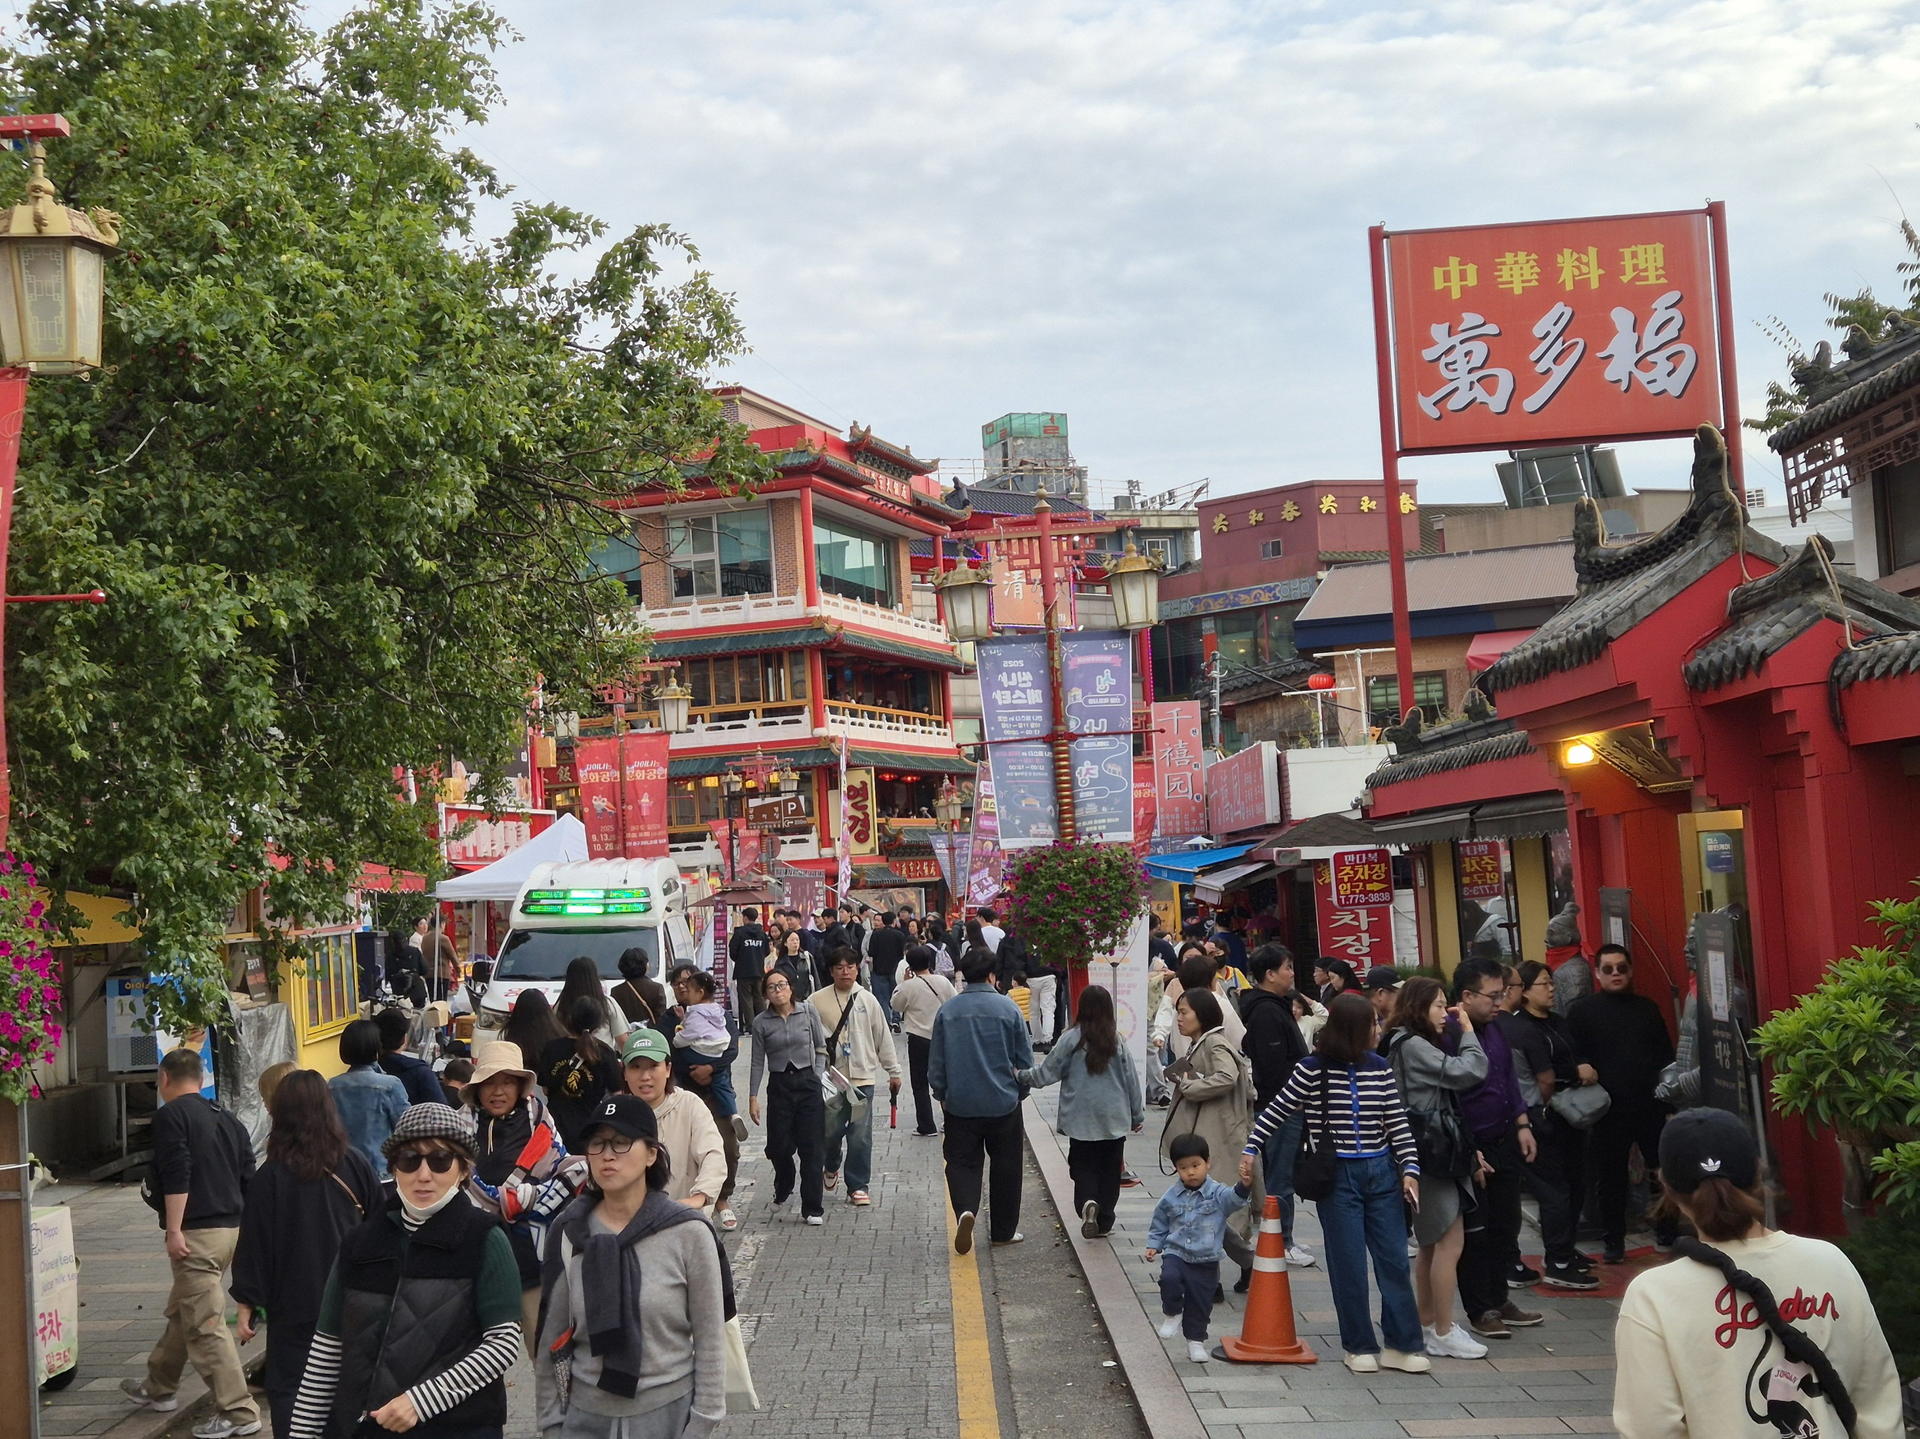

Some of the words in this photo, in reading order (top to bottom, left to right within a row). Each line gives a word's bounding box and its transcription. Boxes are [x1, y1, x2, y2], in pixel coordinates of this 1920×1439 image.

[1433, 243, 1668, 299] 中華料理
[1417, 290, 1697, 420] 萬多福
[1319, 491, 1417, 515] 共和春
[1212, 499, 1301, 534] 共和春
[1160, 708, 1195, 800] 千禧园
[788, 802, 796, 814] P
[846, 781, 871, 844] 연경
[1344, 852, 1378, 865] 만다복
[1338, 863, 1388, 882] 주차장
[1338, 882, 1365, 895] 입구
[1340, 892, 1391, 905] T.773-3838
[744, 939, 763, 947] STAFF
[605, 1103, 616, 1115] B
[1715, 1283, 1839, 1349] Jodan
[1775, 1369, 1798, 1384] JORDAN
